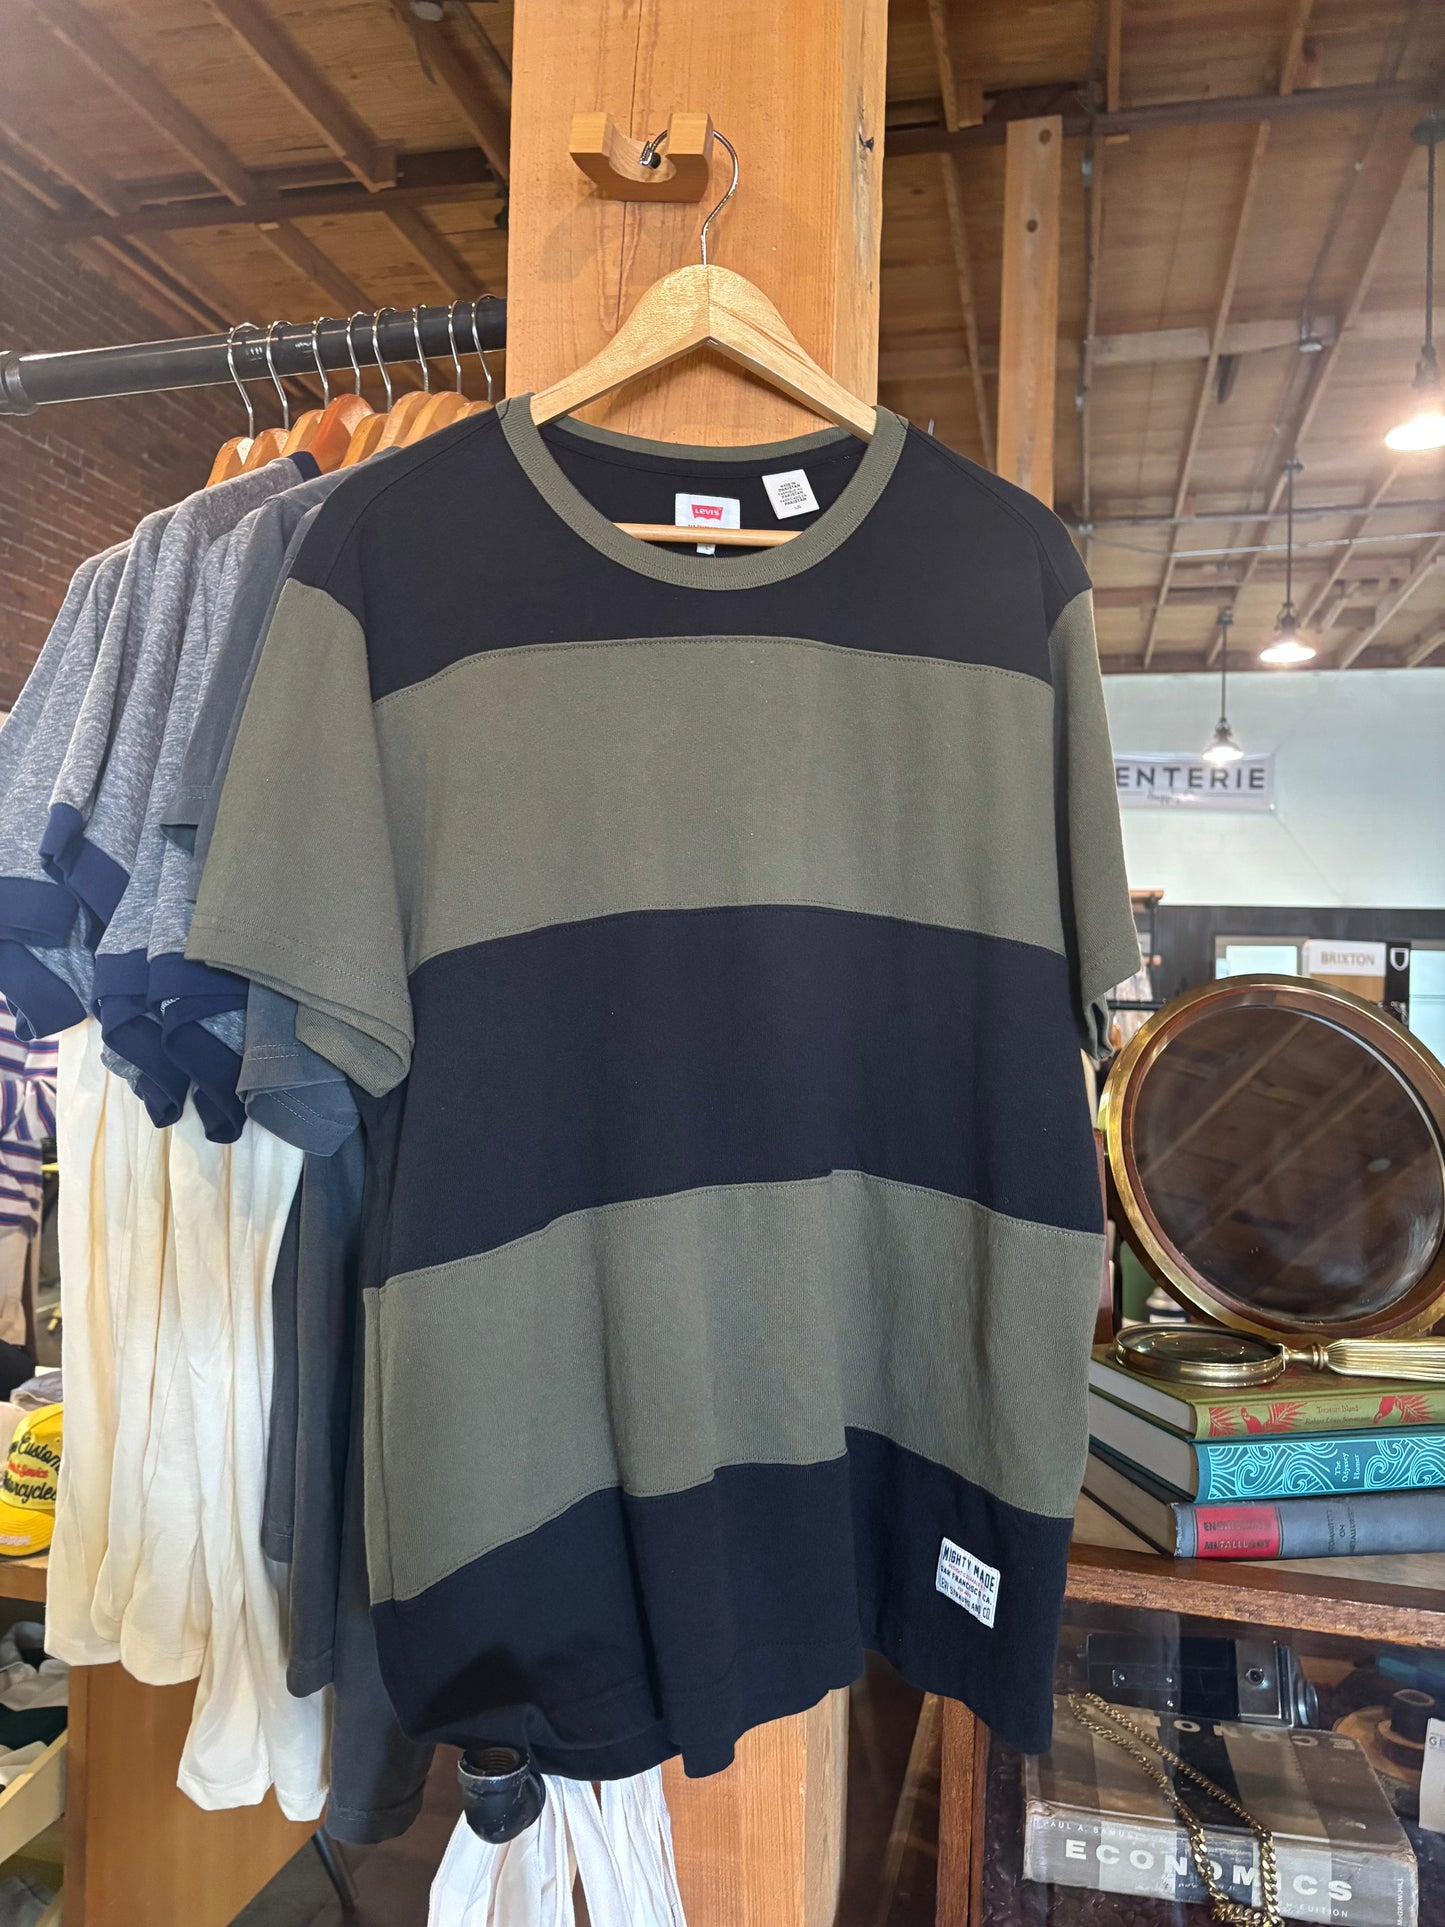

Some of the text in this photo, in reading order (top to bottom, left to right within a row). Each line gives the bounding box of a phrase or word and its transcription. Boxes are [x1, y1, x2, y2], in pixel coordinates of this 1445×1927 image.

[1321, 951, 1375, 966] BRIXTON
[1342, 1452, 1351, 1482] Odyssey
[1339, 1523, 1346, 1538] ON
[940, 1564, 951, 1578] SAN
[951, 1571, 982, 1597] FRANCISCO
[942, 1545, 972, 1570] MIGHTY
[973, 1564, 995, 1593] MADE
